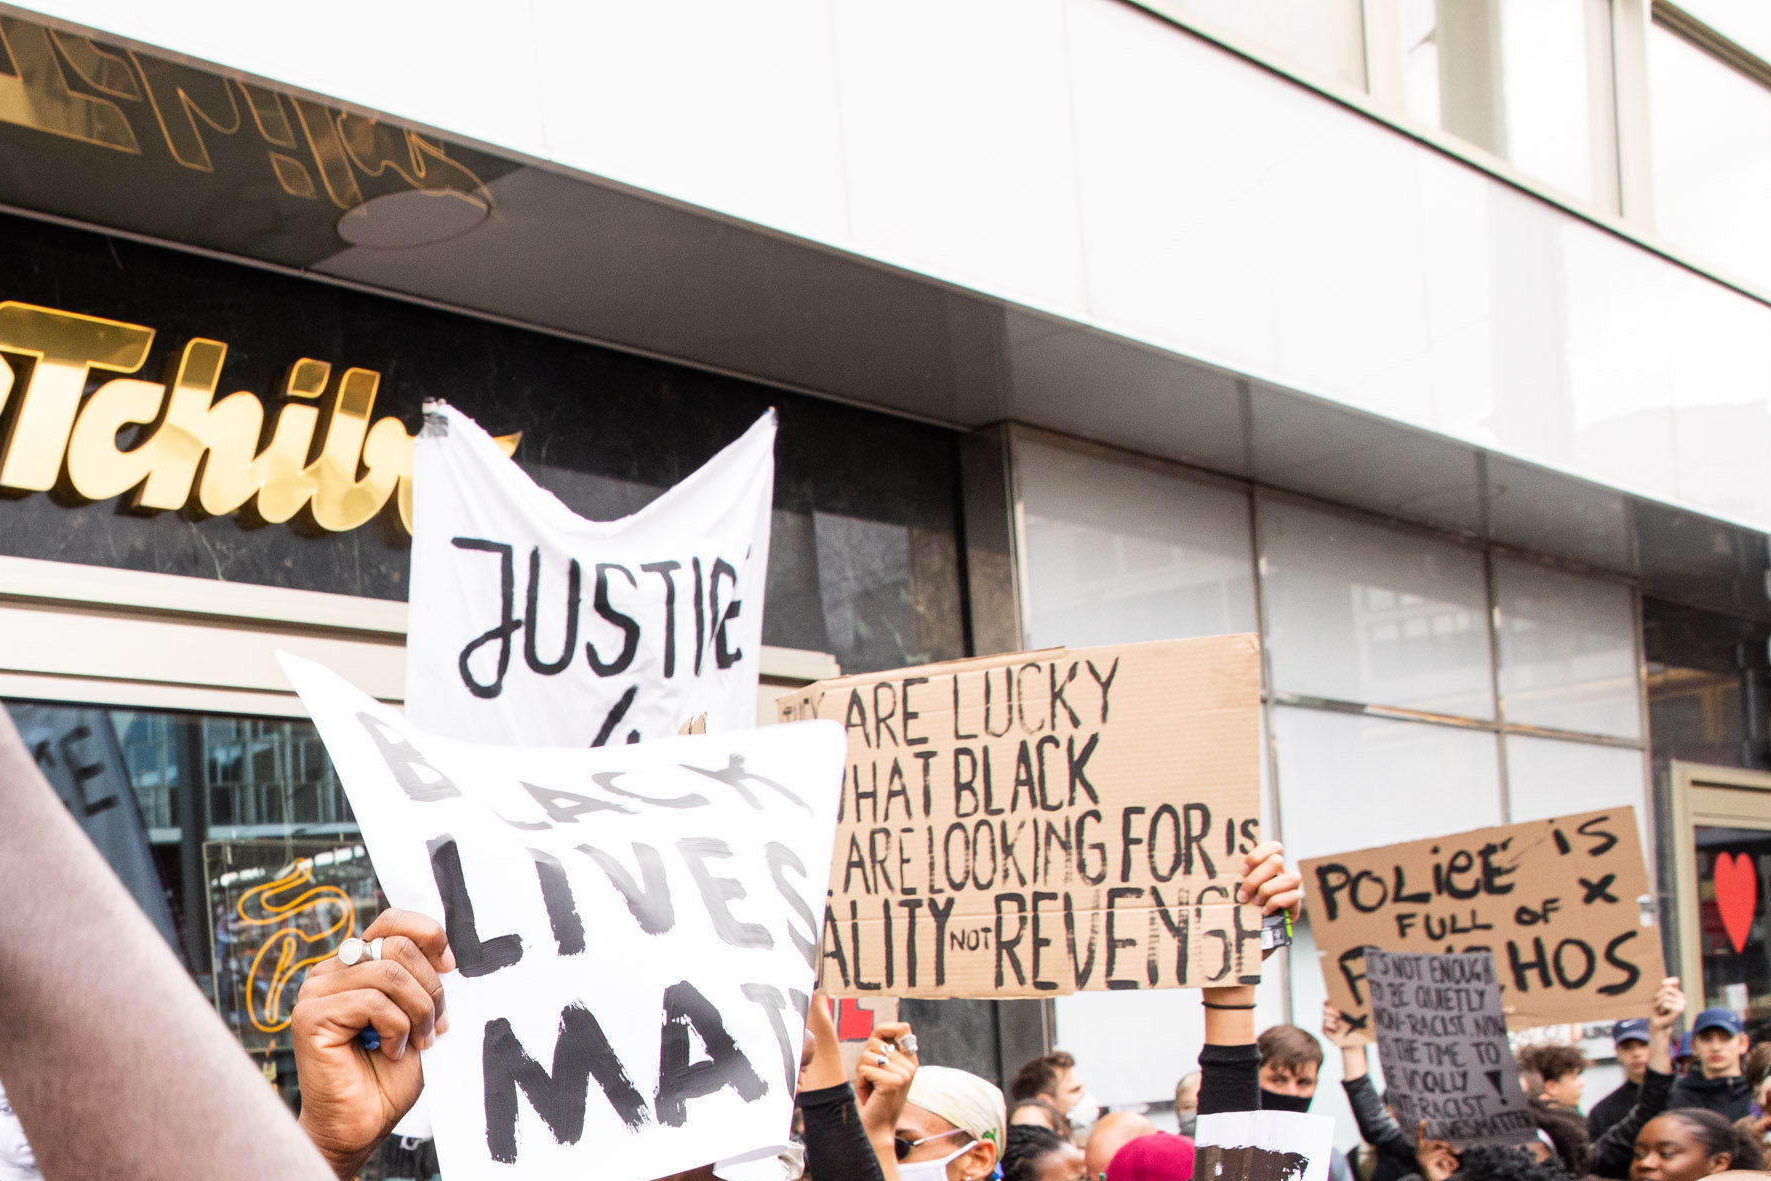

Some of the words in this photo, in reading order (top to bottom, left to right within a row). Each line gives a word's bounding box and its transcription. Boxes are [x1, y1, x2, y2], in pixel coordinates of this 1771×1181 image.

[845, 676, 930, 749] ARE
[953, 656, 1120, 740] LUCKY
[837, 749, 938, 824] HAT
[954, 732, 1100, 819] BLACK
[842, 827, 917, 896] ARE
[927, 808, 1108, 892] LOOKING
[1120, 802, 1218, 883] FOR
[426, 833, 818, 978] LIVES
[815, 895, 955, 993] ALITY
[949, 926, 993, 952] NOT
[994, 881, 1262, 991] REVENGE
[1395, 908, 1494, 941] FULL
[1514, 898, 1561, 926] OF
[1415, 985, 1486, 1012] QUIETLY
[482, 980, 810, 1165] MAT
[1470, 1041, 1501, 1065] TO
